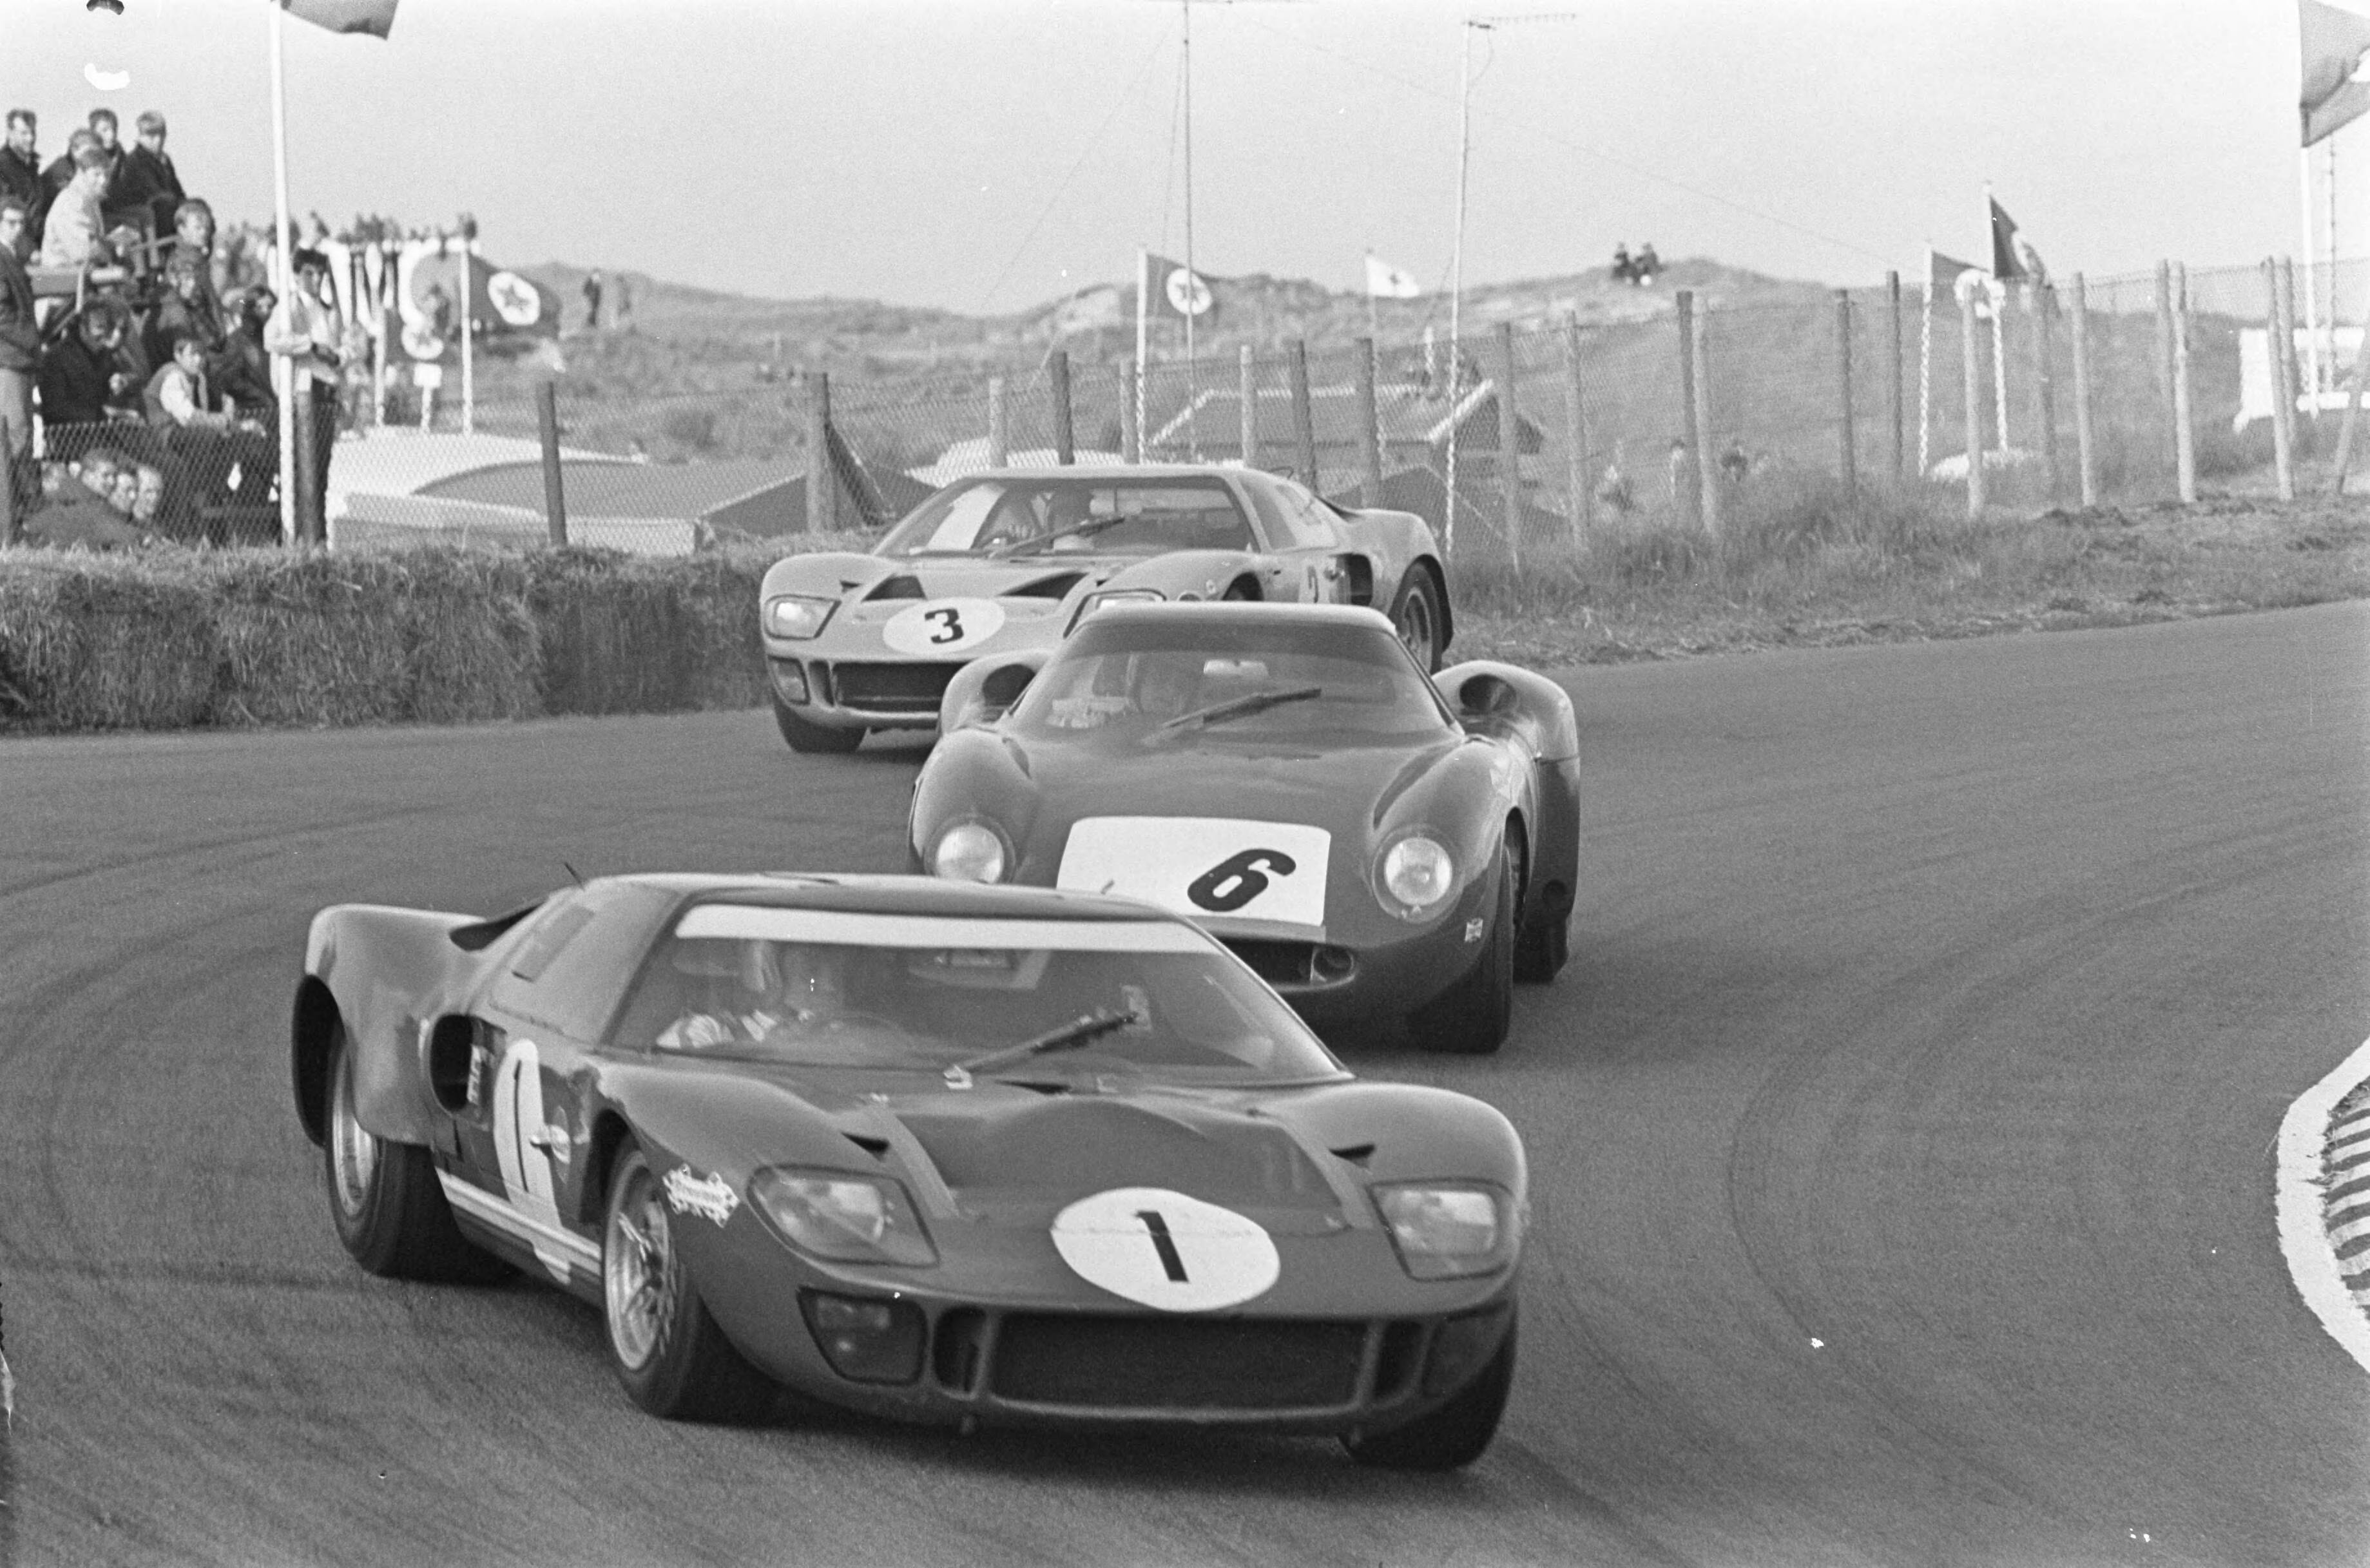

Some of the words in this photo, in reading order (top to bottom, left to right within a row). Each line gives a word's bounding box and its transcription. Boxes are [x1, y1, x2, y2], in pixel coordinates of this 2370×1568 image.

[924, 608, 965, 644] 3
[1187, 848, 1297, 912] 6
[513, 1058, 530, 1194] 1
[1133, 1210, 1189, 1283] 1
